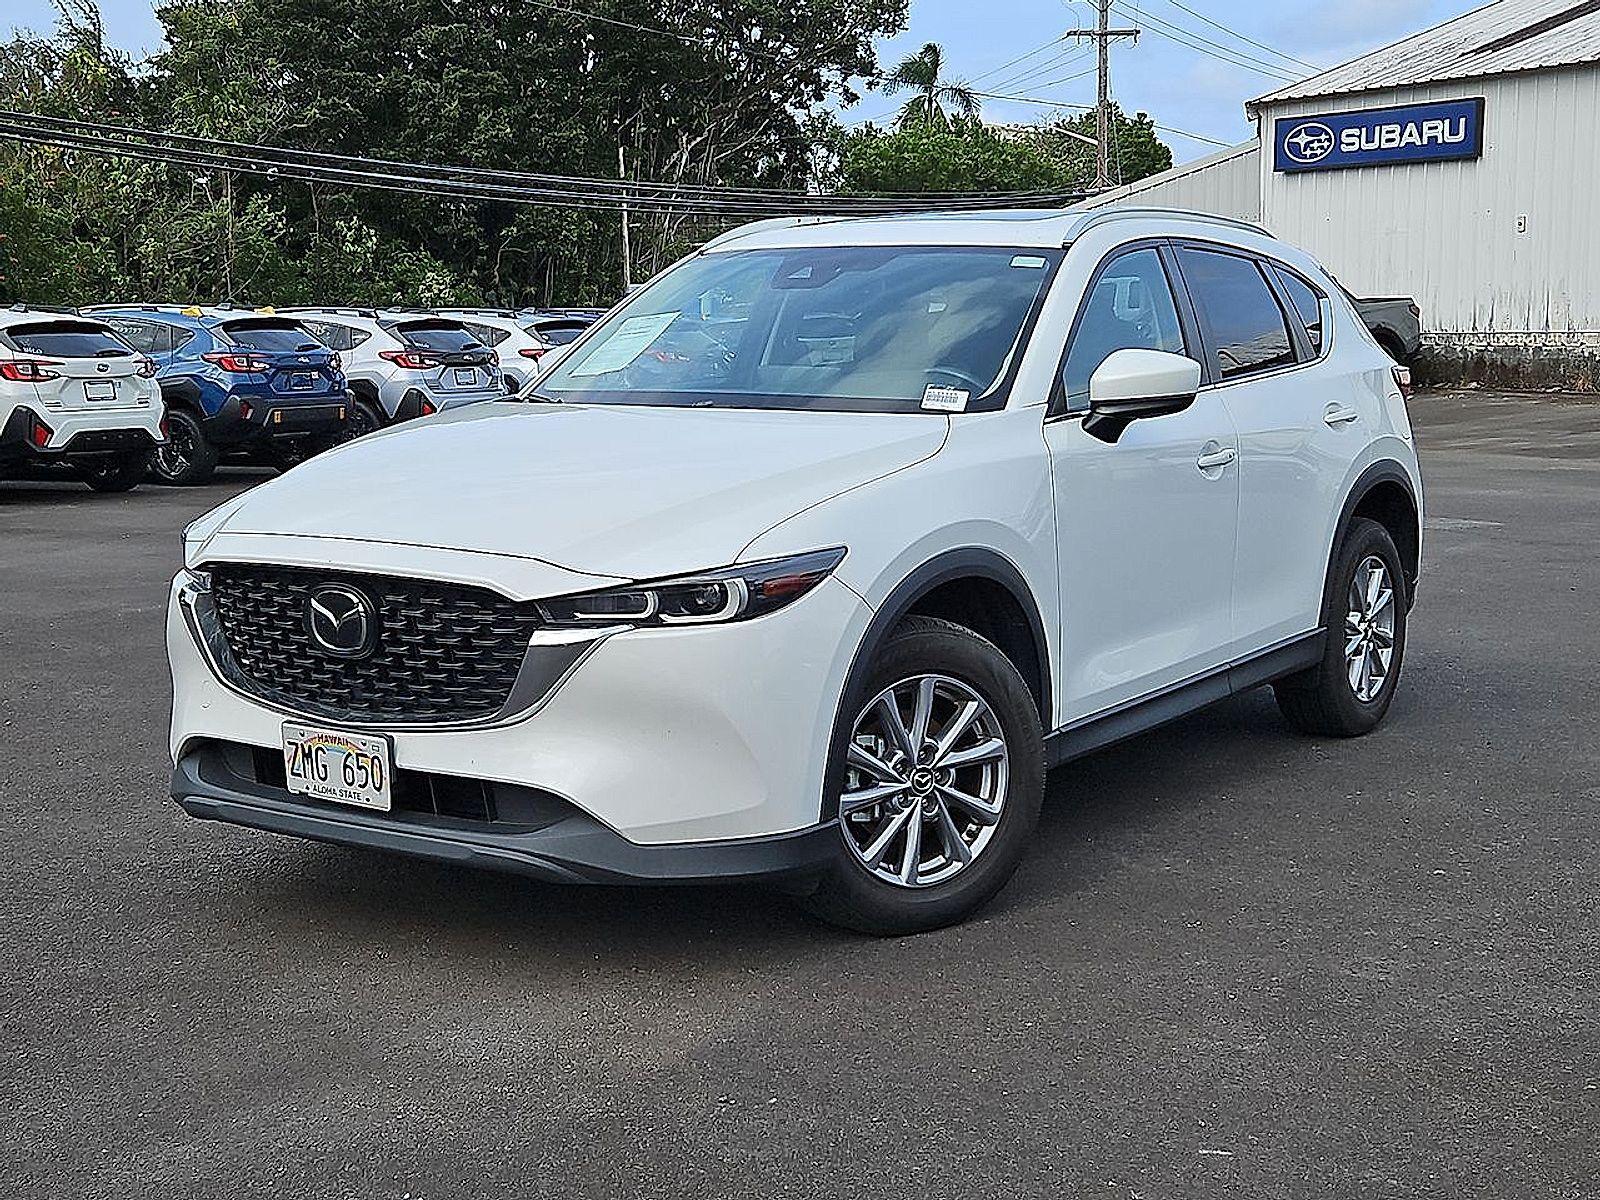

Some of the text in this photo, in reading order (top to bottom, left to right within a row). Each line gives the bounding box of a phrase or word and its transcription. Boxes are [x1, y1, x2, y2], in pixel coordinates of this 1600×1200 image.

[1340, 117, 1466, 152] SUBARU
[317, 733, 349, 746] HAWAII
[287, 740, 383, 792] ZMG 650
[312, 784, 362, 801] ALOHA STATE
